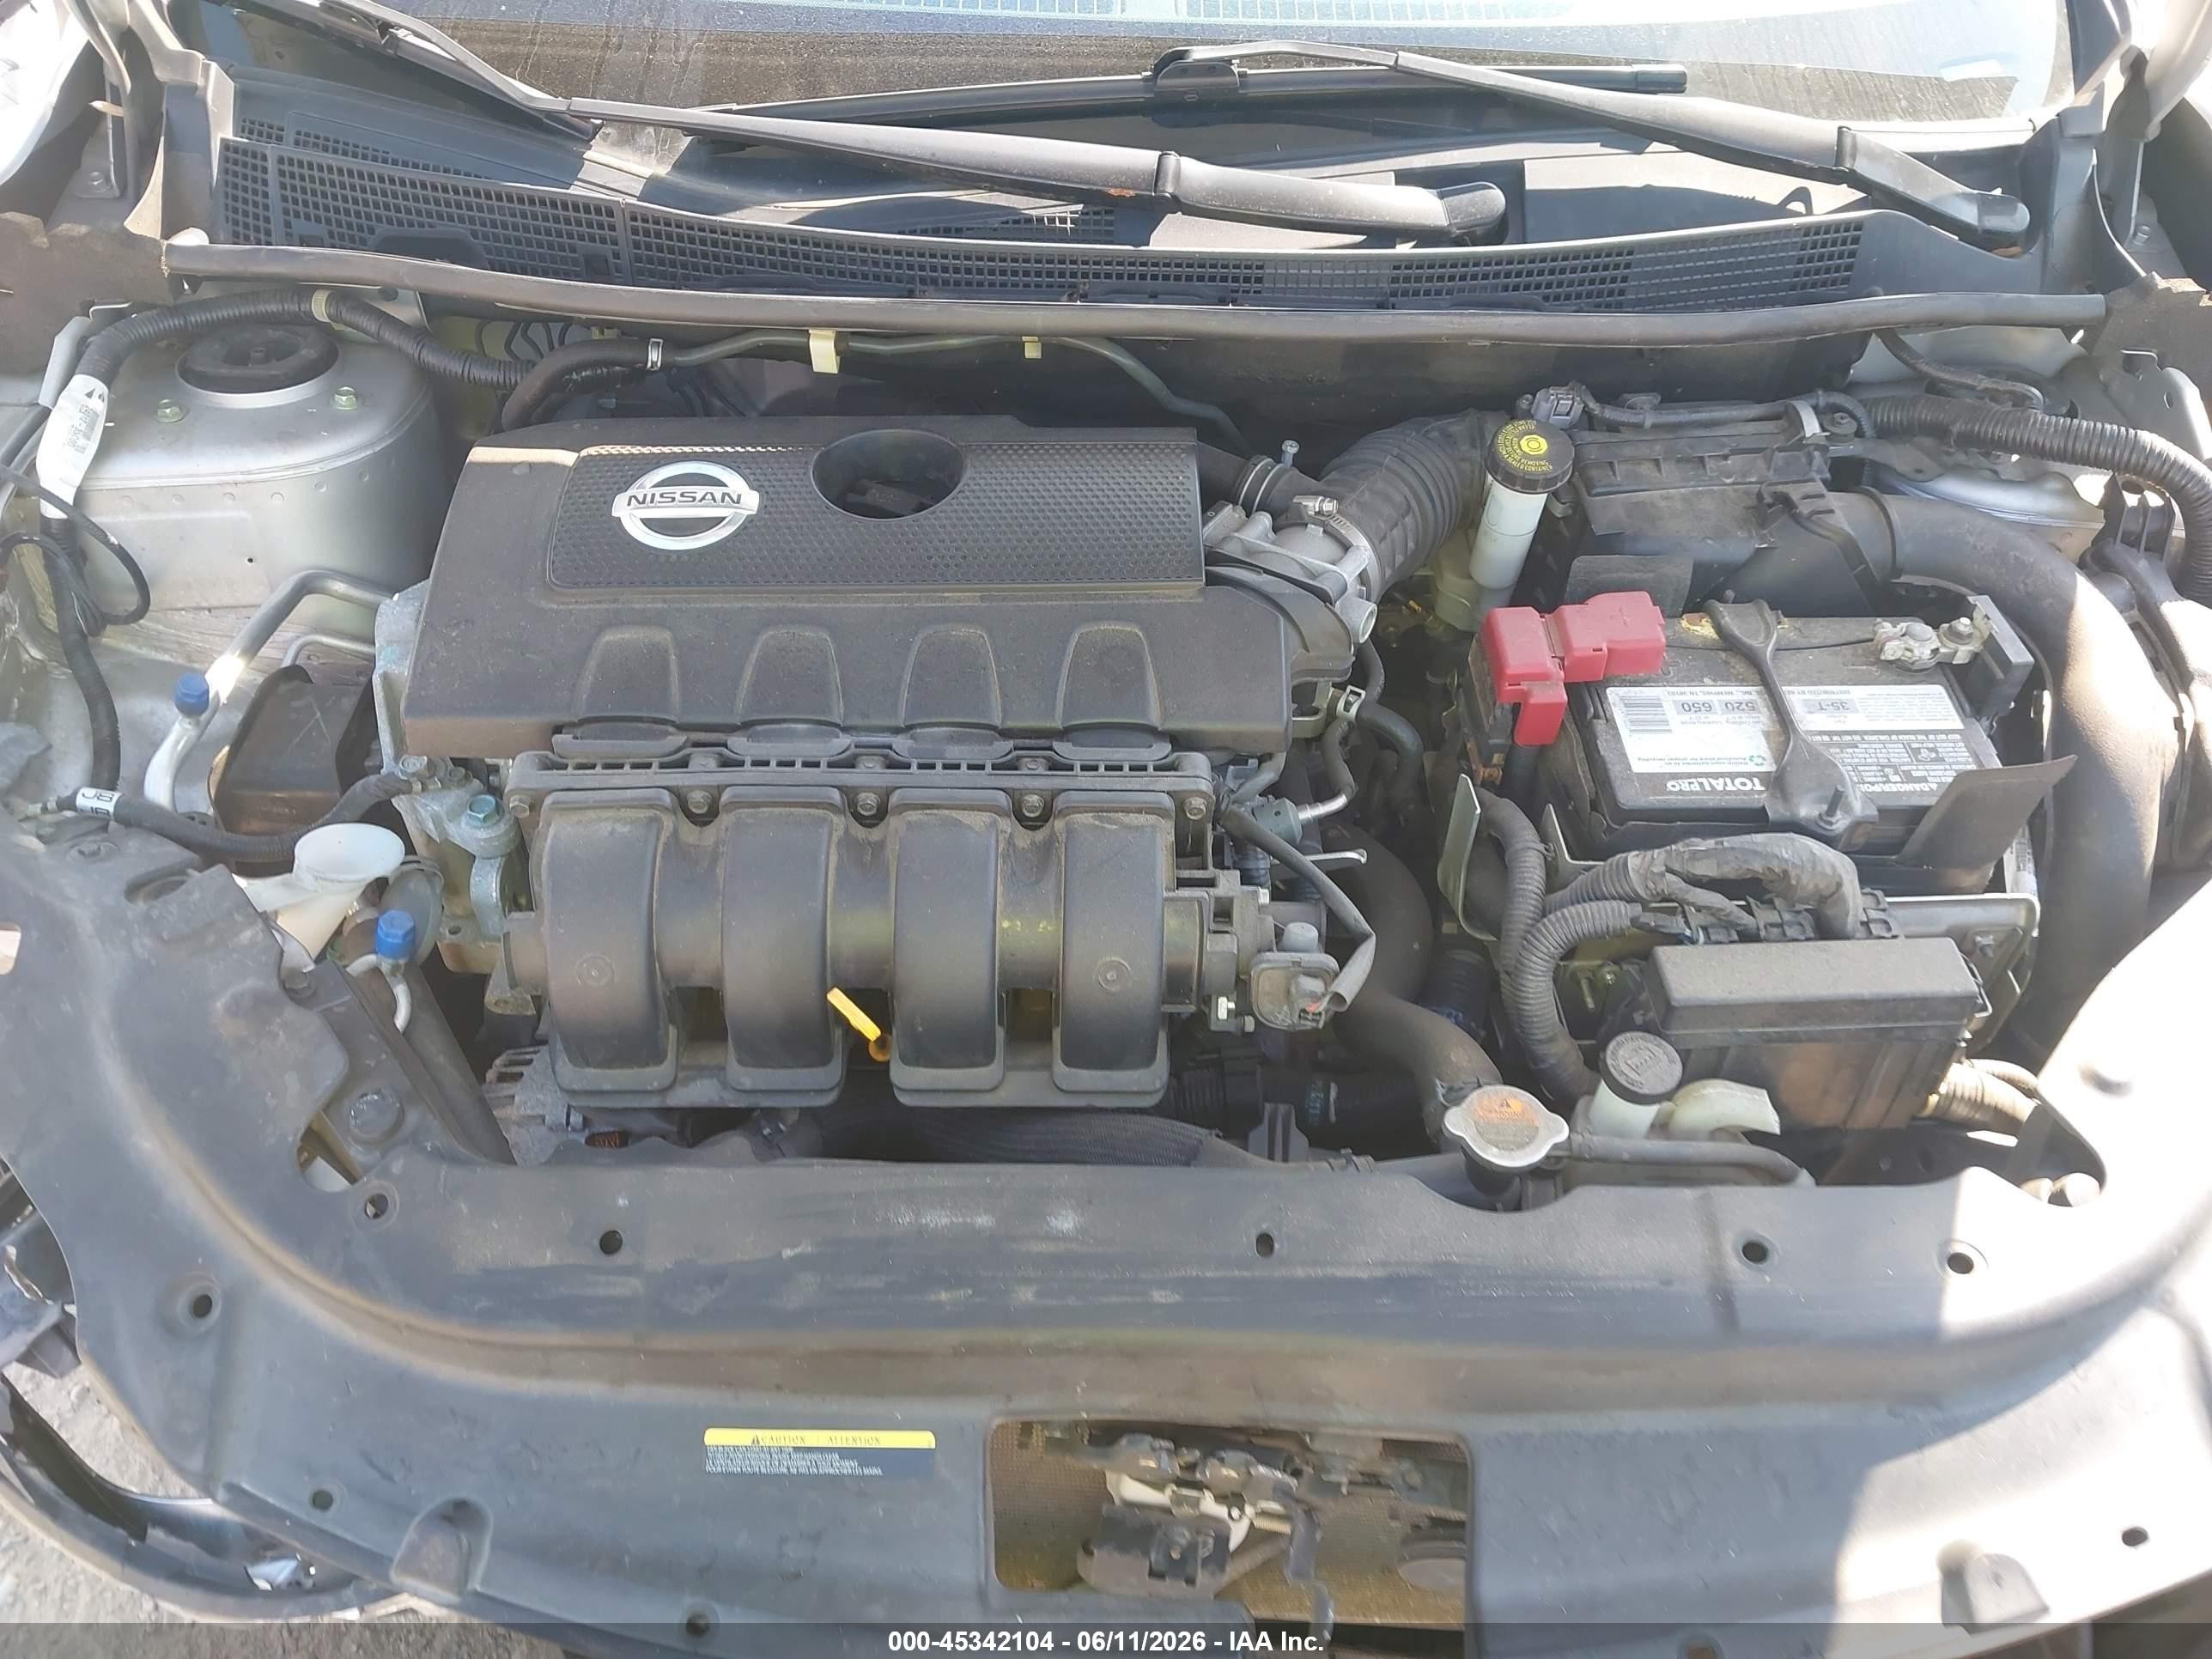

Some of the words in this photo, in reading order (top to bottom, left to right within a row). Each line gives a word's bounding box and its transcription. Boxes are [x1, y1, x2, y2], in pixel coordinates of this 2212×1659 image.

[627, 491, 742, 507] NISSAN
[1680, 701, 1713, 714] 650
[1723, 701, 1756, 713] 520
[1818, 701, 1850, 712] 35-T
[1665, 776, 1767, 792] TOTALPRO
[761, 1435, 806, 1445] CAUTION
[827, 1435, 881, 1446] ATTENTION
